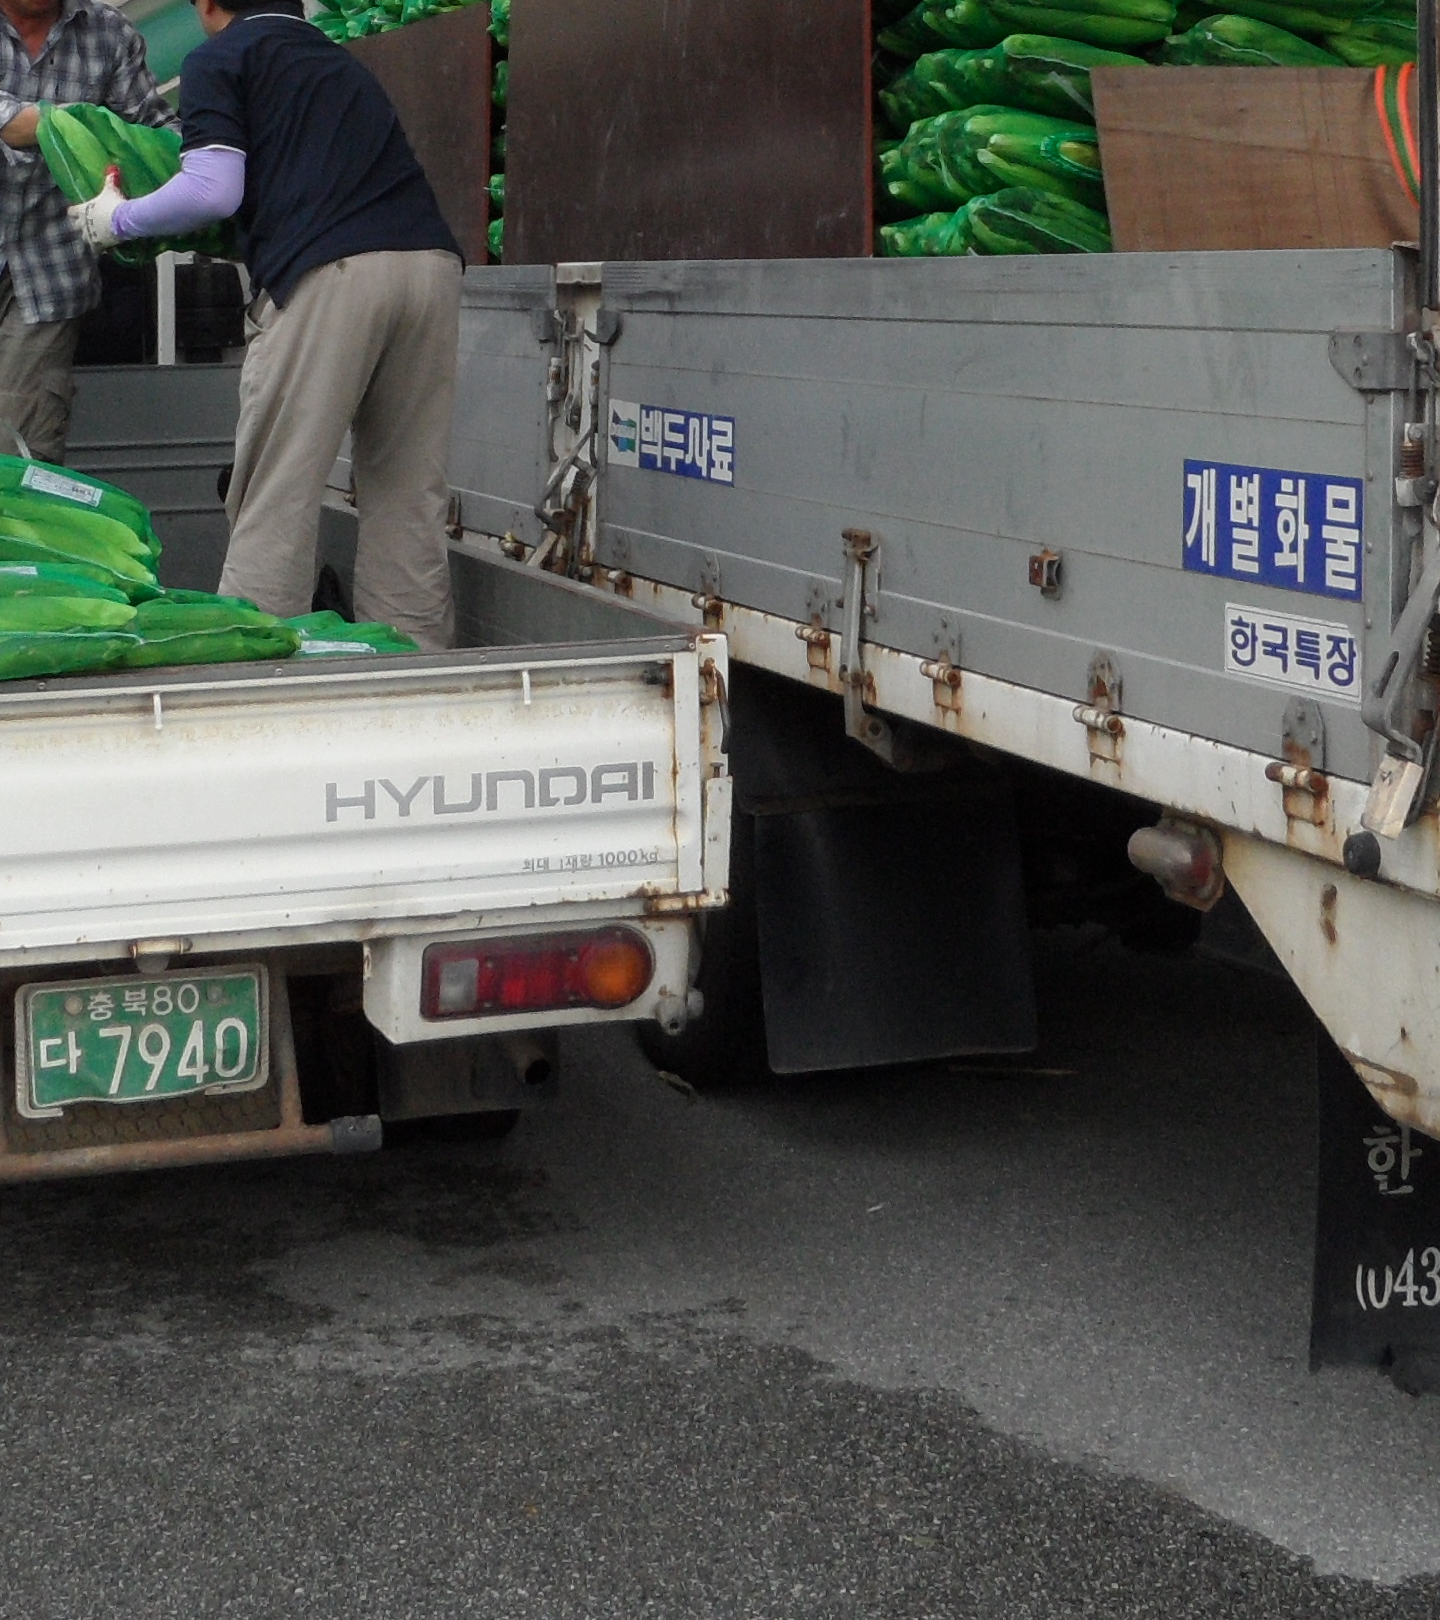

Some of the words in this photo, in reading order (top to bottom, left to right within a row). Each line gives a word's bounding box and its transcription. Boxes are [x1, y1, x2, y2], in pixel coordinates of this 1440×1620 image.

[641, 408, 734, 482] 백두사료
[1185, 468, 1360, 591] 개별화물
[1230, 615, 1357, 687] 한국특장
[325, 760, 656, 822] HYUNDAI
